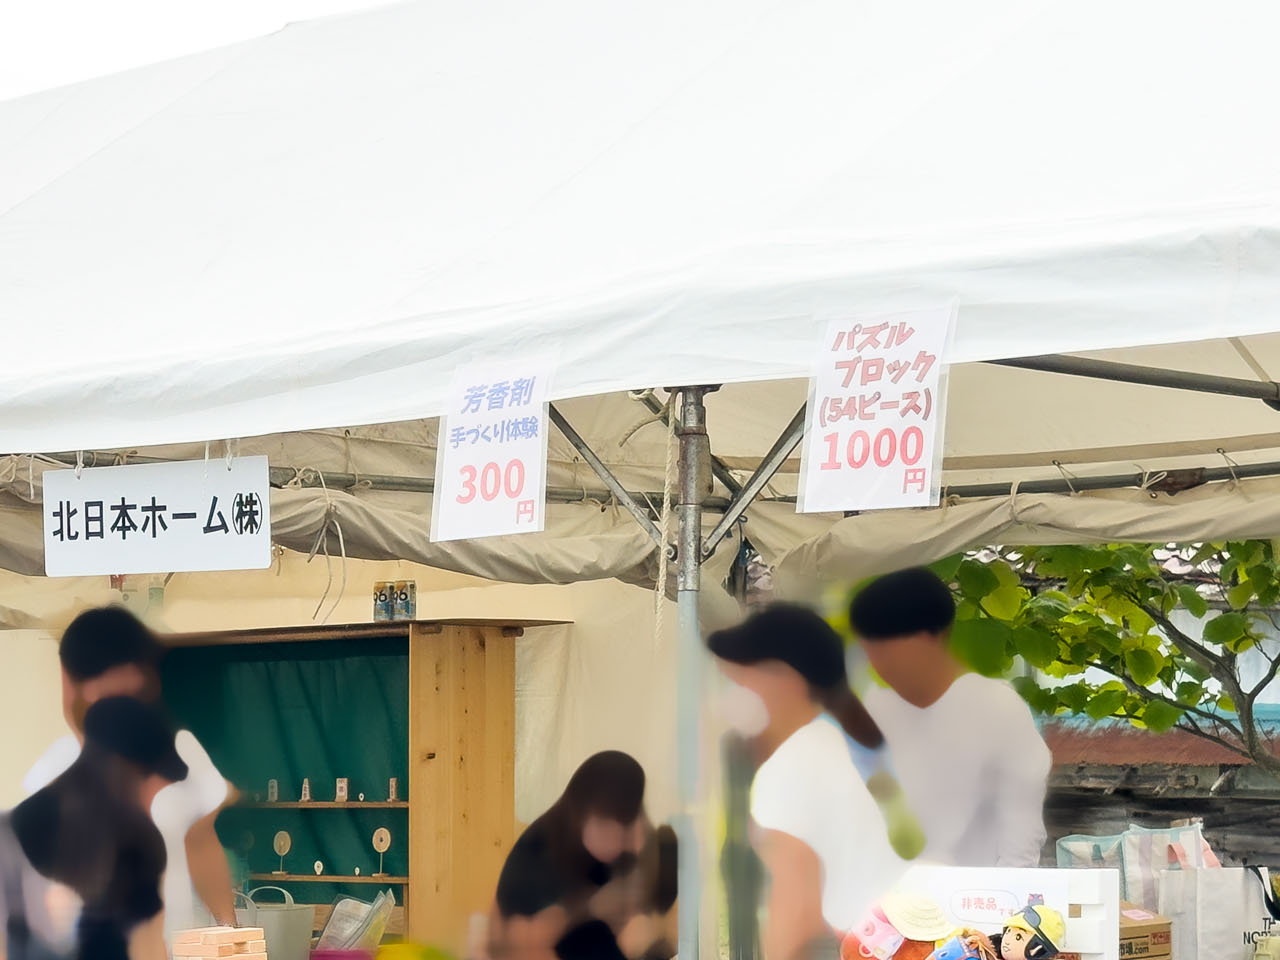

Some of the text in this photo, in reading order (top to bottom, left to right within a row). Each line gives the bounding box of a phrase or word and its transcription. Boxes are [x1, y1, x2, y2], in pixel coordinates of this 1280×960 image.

[832, 321, 915, 353] パズル
[834, 350, 937, 388] ブロック
[461, 375, 536, 415] 芳香剤
[820, 387, 933, 428] (54ピース)
[449, 416, 539, 449] 手づくり体験
